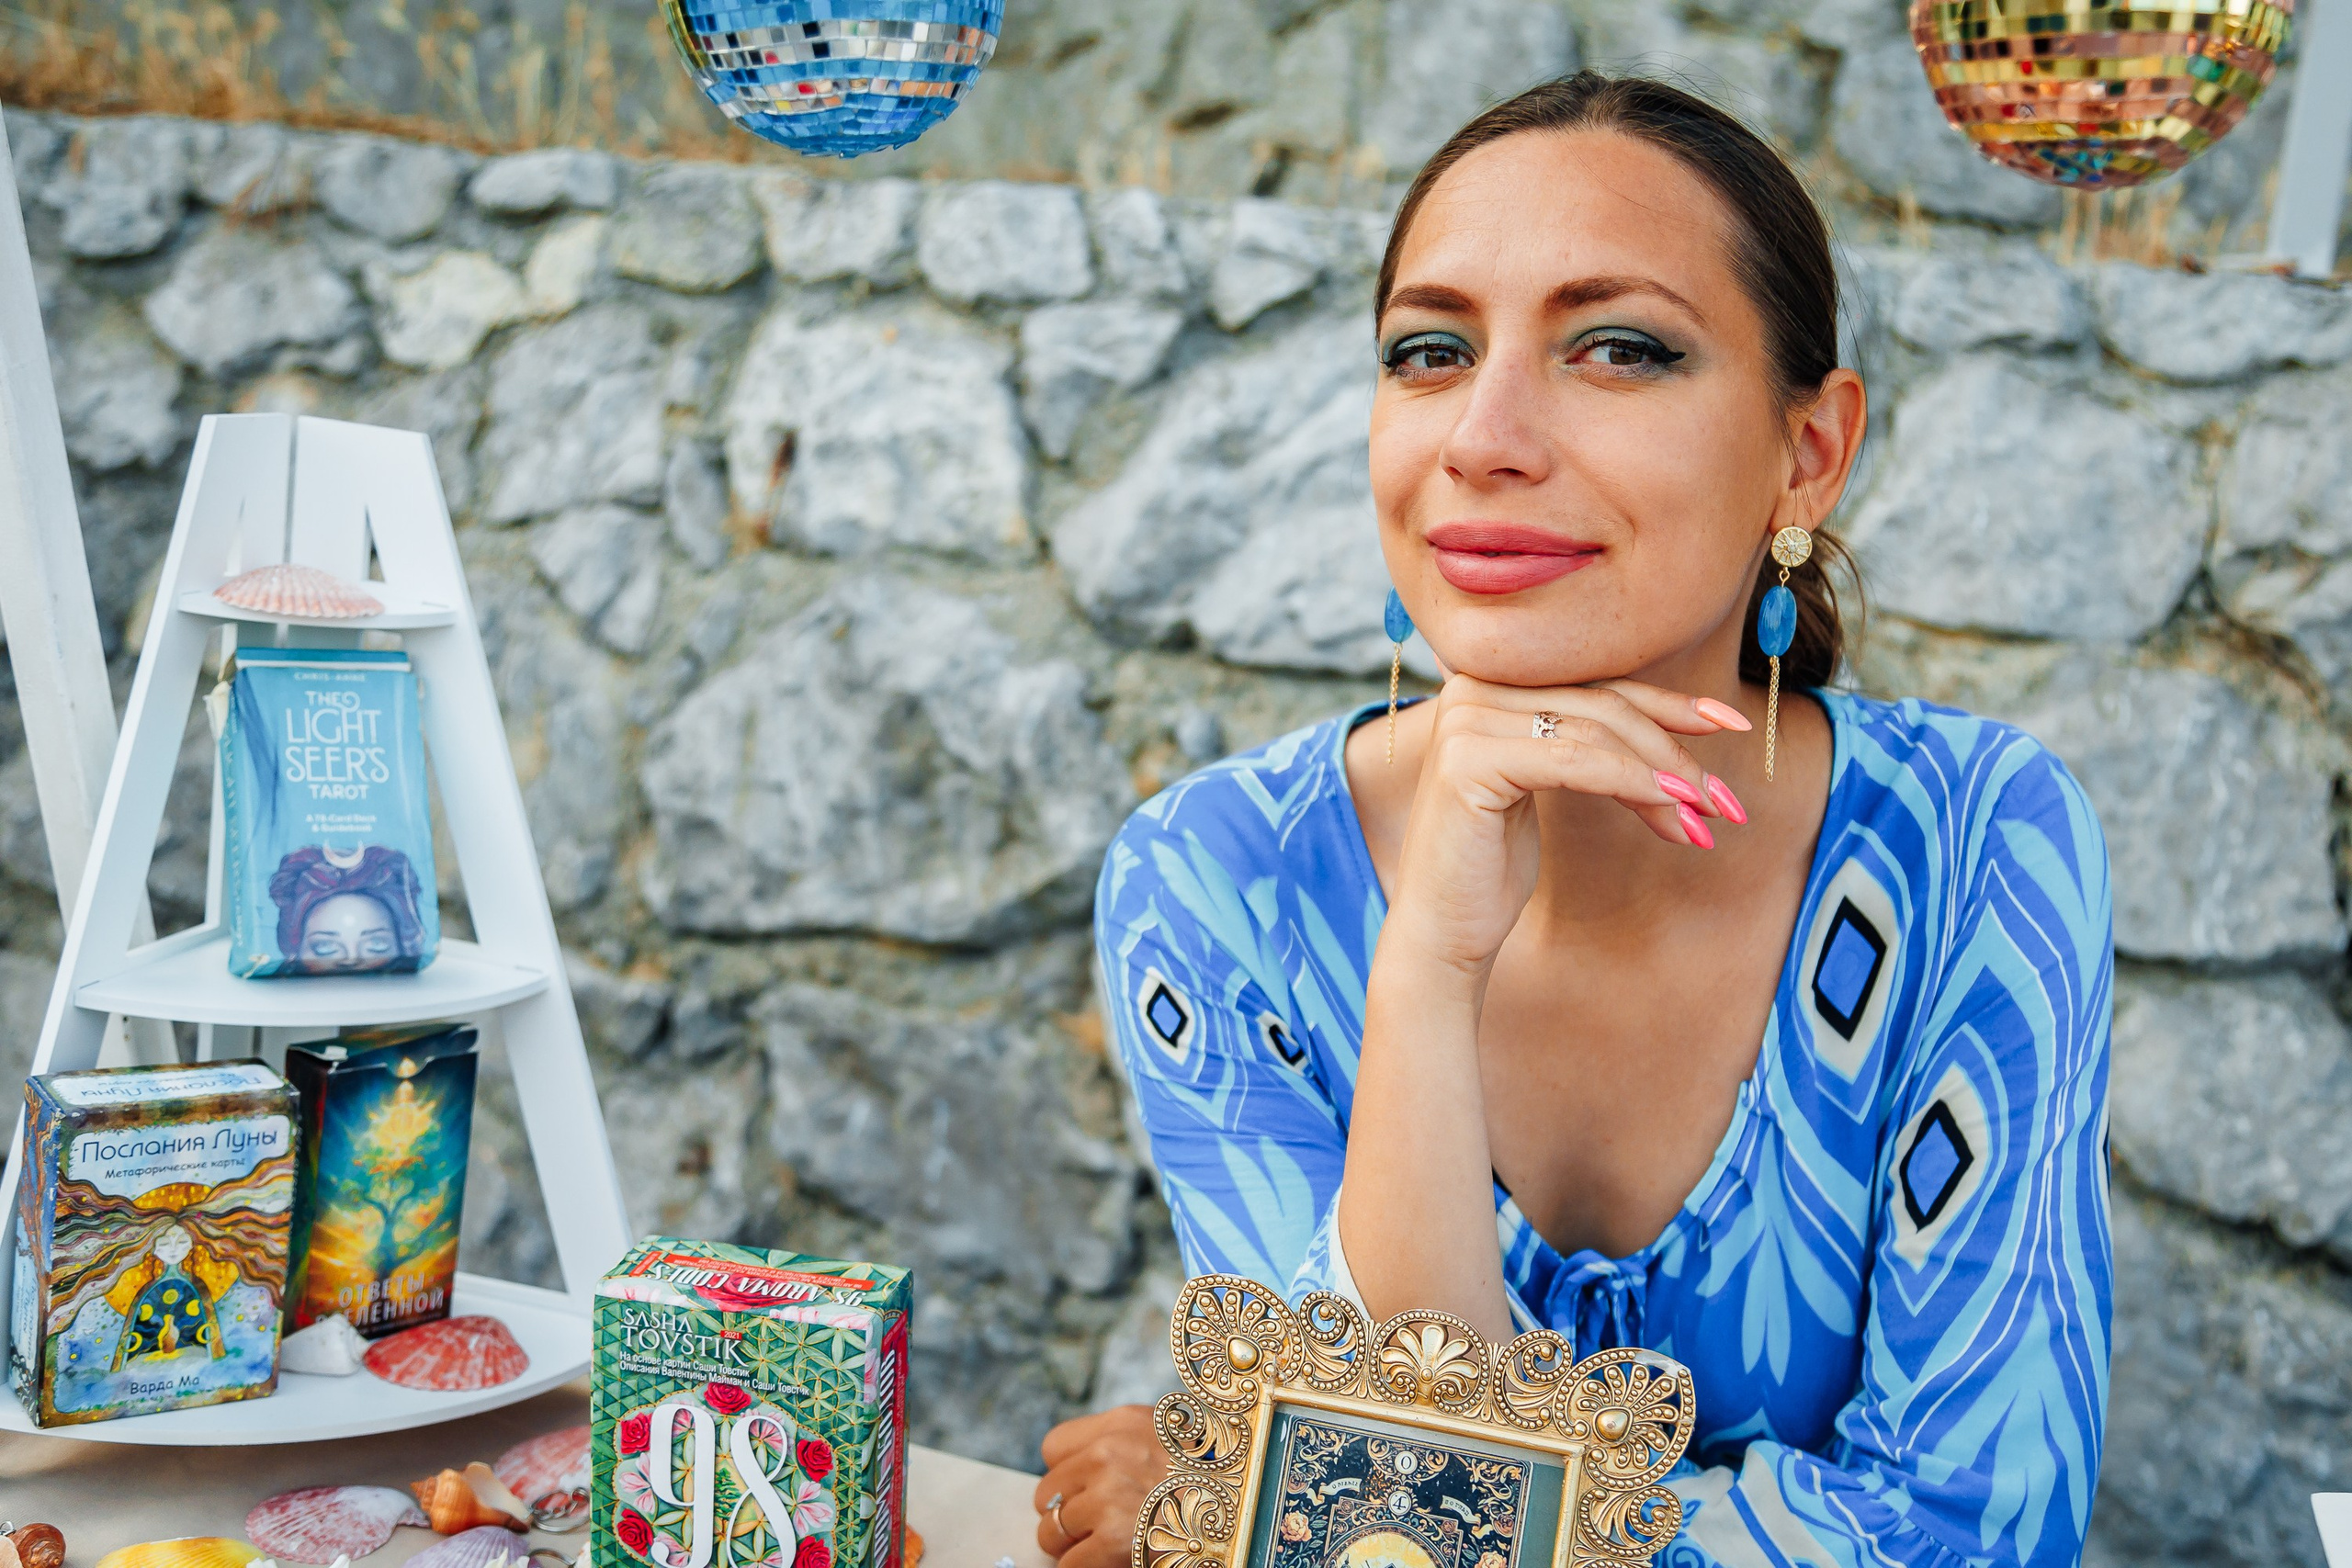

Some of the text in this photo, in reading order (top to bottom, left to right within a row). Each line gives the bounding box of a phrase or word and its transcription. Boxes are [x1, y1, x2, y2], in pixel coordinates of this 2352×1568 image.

[304, 691, 360, 712] THE
[286, 708, 381, 744] LIGHT
[285, 746, 390, 784] SEER'S
[308, 784, 370, 800] TAROT
[82, 1129, 277, 1163] Послания Луны
[105, 1157, 246, 1179] Метафорические карты
[338, 1272, 425, 1309] ОТВЕТЫ
[647, 1264, 866, 1307] 98 AROMA CODES
[625, 1308, 693, 1334] SASHA
[724, 1330, 740, 1339] 2021
[620, 1325, 750, 1368] TOVSTIK
[620, 1351, 750, 1378] На основе картин Саши Товстик
[620, 1361, 809, 1396] Описания Валентины Майман и Саши Товстик
[130, 1375, 199, 1395] Варда Ма
[649, 1404, 797, 1568] 98
